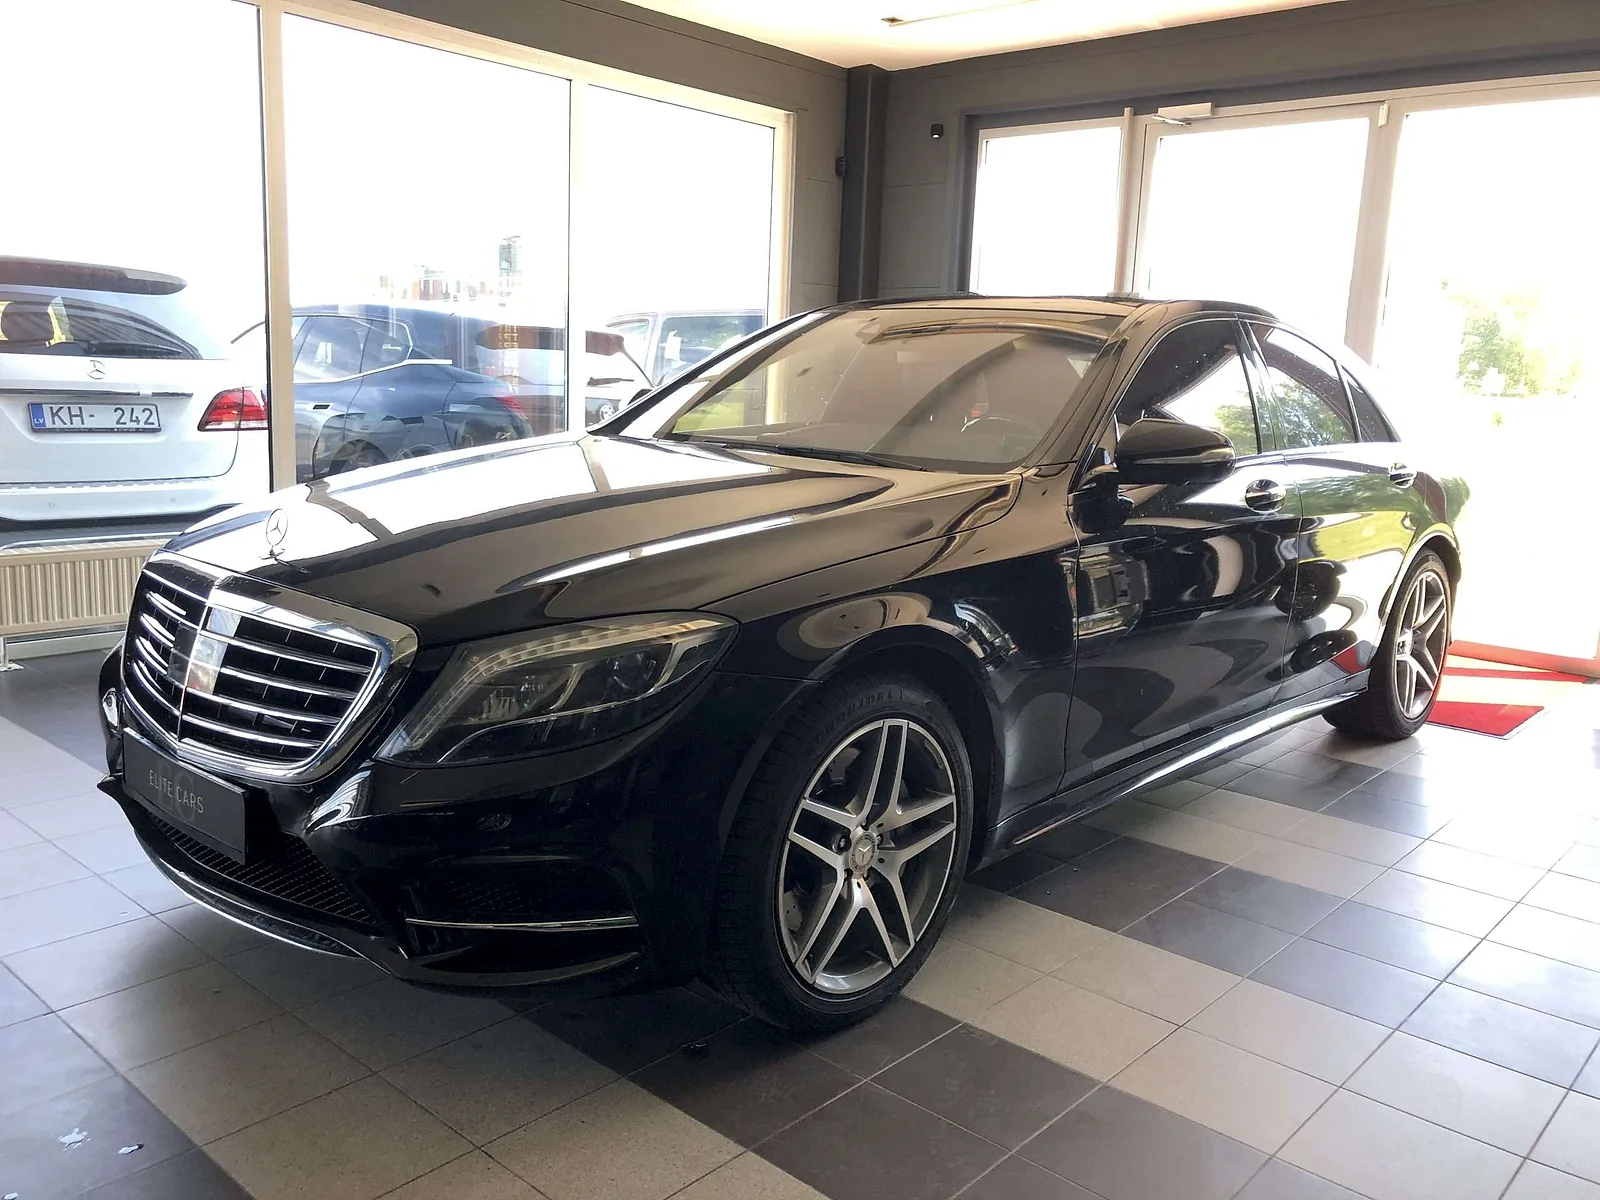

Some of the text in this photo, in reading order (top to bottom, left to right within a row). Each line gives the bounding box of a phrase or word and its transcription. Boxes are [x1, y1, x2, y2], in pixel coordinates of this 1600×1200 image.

[113, 407, 155, 426] 242
[149, 769, 204, 814] ELITE CARS
